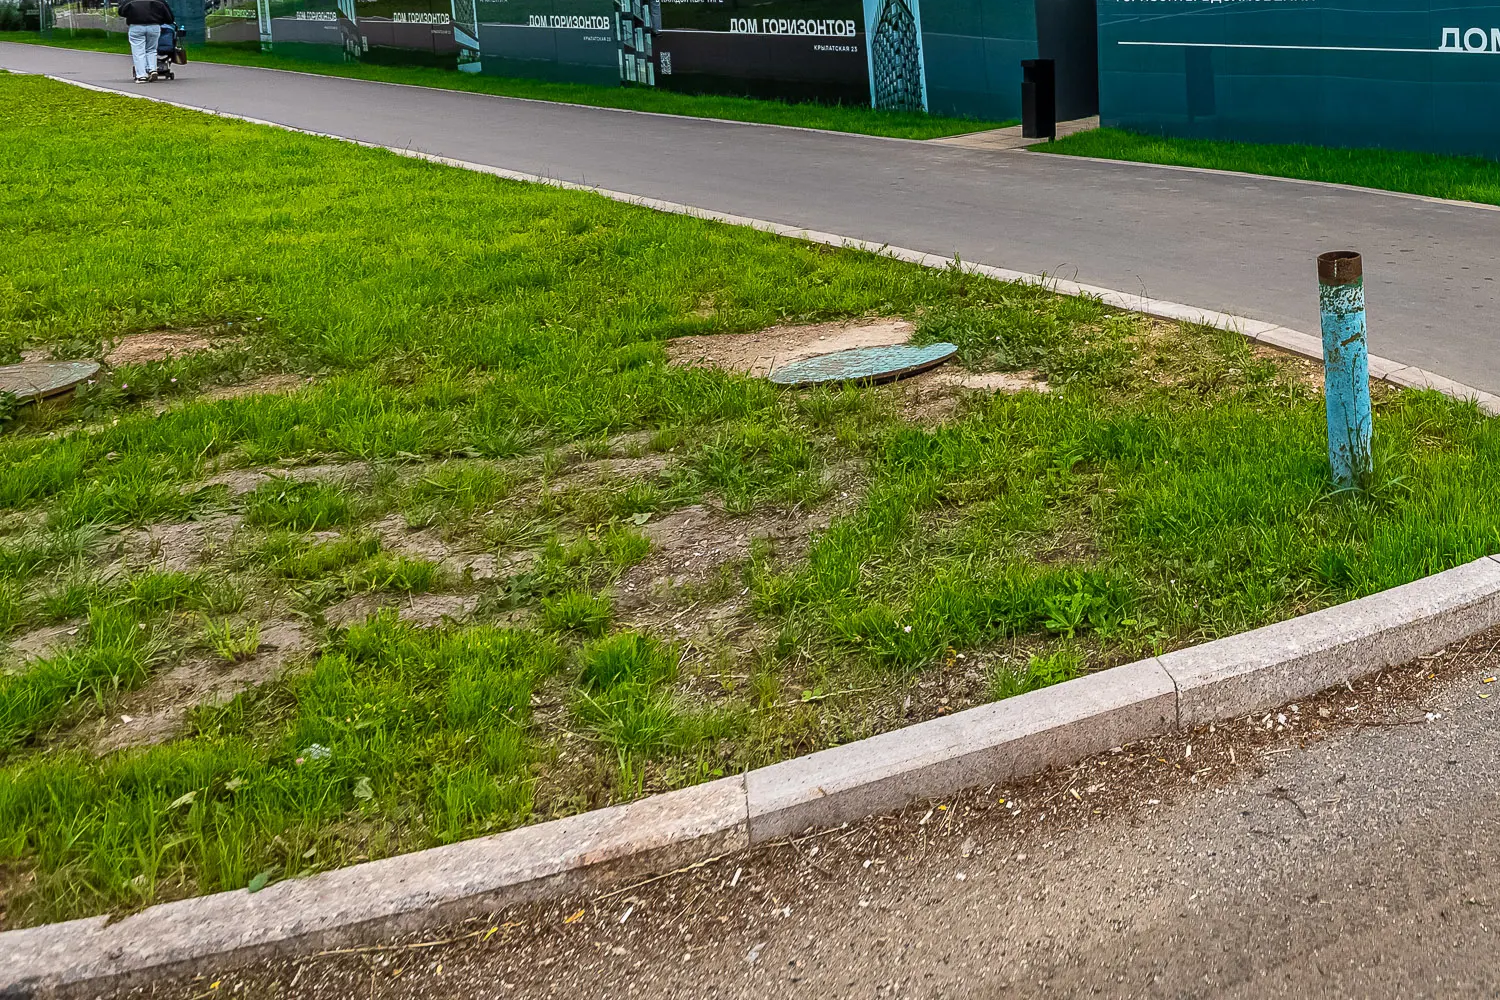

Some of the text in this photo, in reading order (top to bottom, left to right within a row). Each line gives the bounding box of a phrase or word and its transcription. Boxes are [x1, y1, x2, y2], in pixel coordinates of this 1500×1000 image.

[408, 13, 450, 25] ГОРИЗОНТОВ
[529, 14, 610, 30] ДОМ ГОРИЗОНТОВ
[730, 18, 856, 37] ДОМ ГОРИЗОНТОВ
[813, 44, 850, 52] КРЫЛАТСКАЯ
